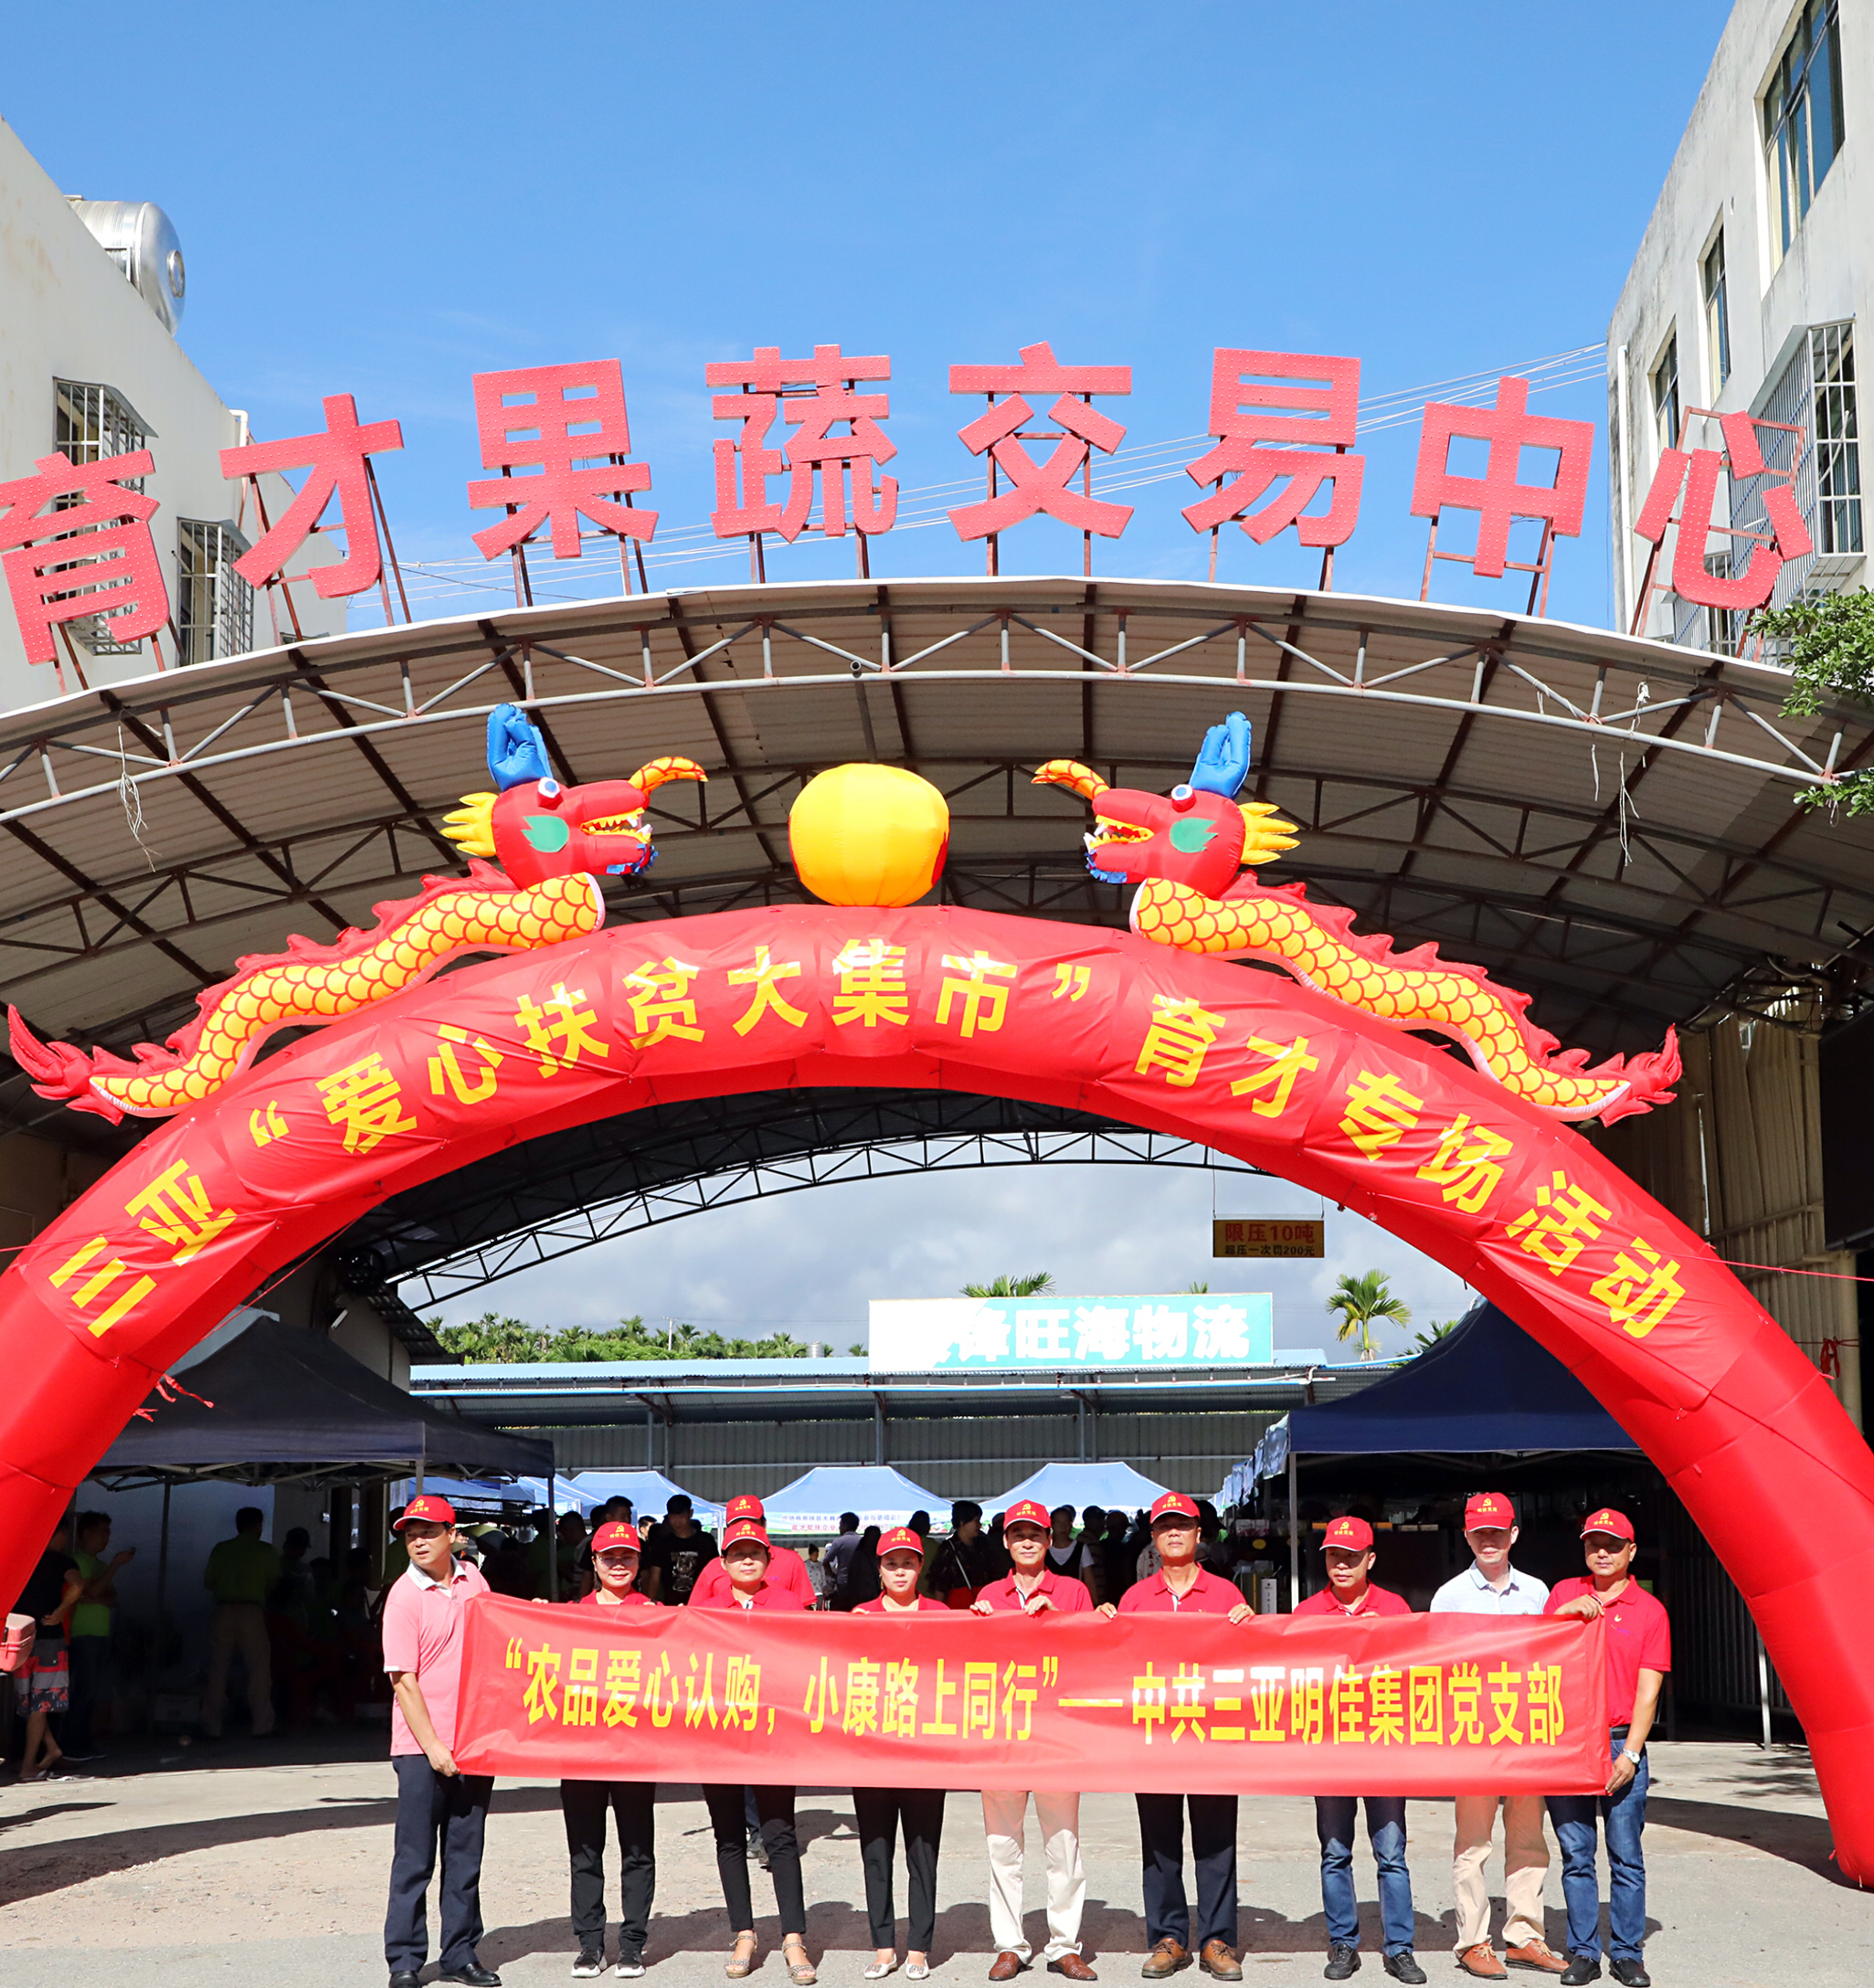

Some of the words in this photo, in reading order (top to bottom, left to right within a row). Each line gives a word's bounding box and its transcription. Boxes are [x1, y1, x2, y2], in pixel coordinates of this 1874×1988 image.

[0, 344, 1814, 665] 育才果蔬交易中心
[1224, 1222, 1315, 1243] 限压10吨
